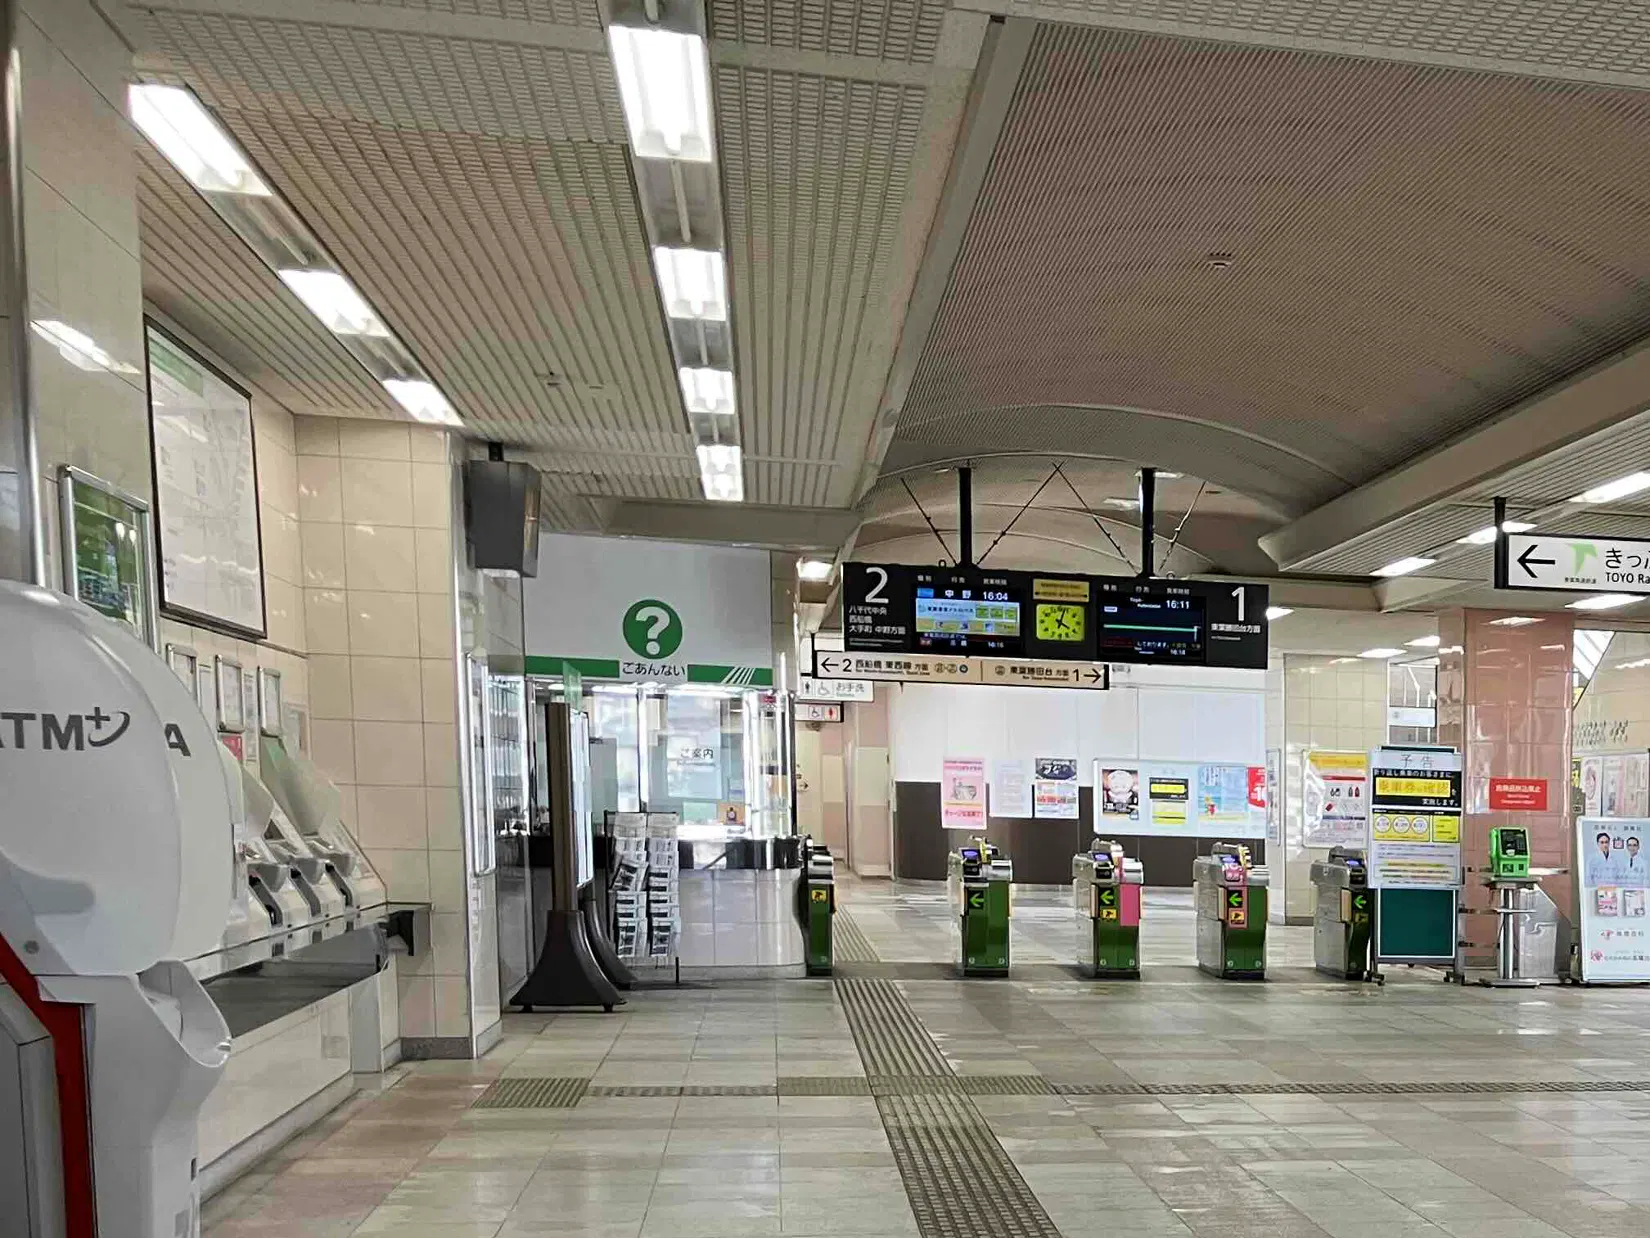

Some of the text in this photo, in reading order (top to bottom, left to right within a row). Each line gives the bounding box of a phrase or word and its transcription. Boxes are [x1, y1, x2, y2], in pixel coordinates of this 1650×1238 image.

[865, 566, 889, 604] 2
[1605, 572, 1634, 584] TOYO
[983, 591, 1008, 601] 16:04
[1166, 600, 1190, 609] 16:11
[1231, 586, 1245, 621] 1
[622, 661, 687, 677] ごあんない
[842, 658, 852, 673] 2
[1072, 668, 1080, 681] 1
[1401, 754, 1434, 768] 予告
